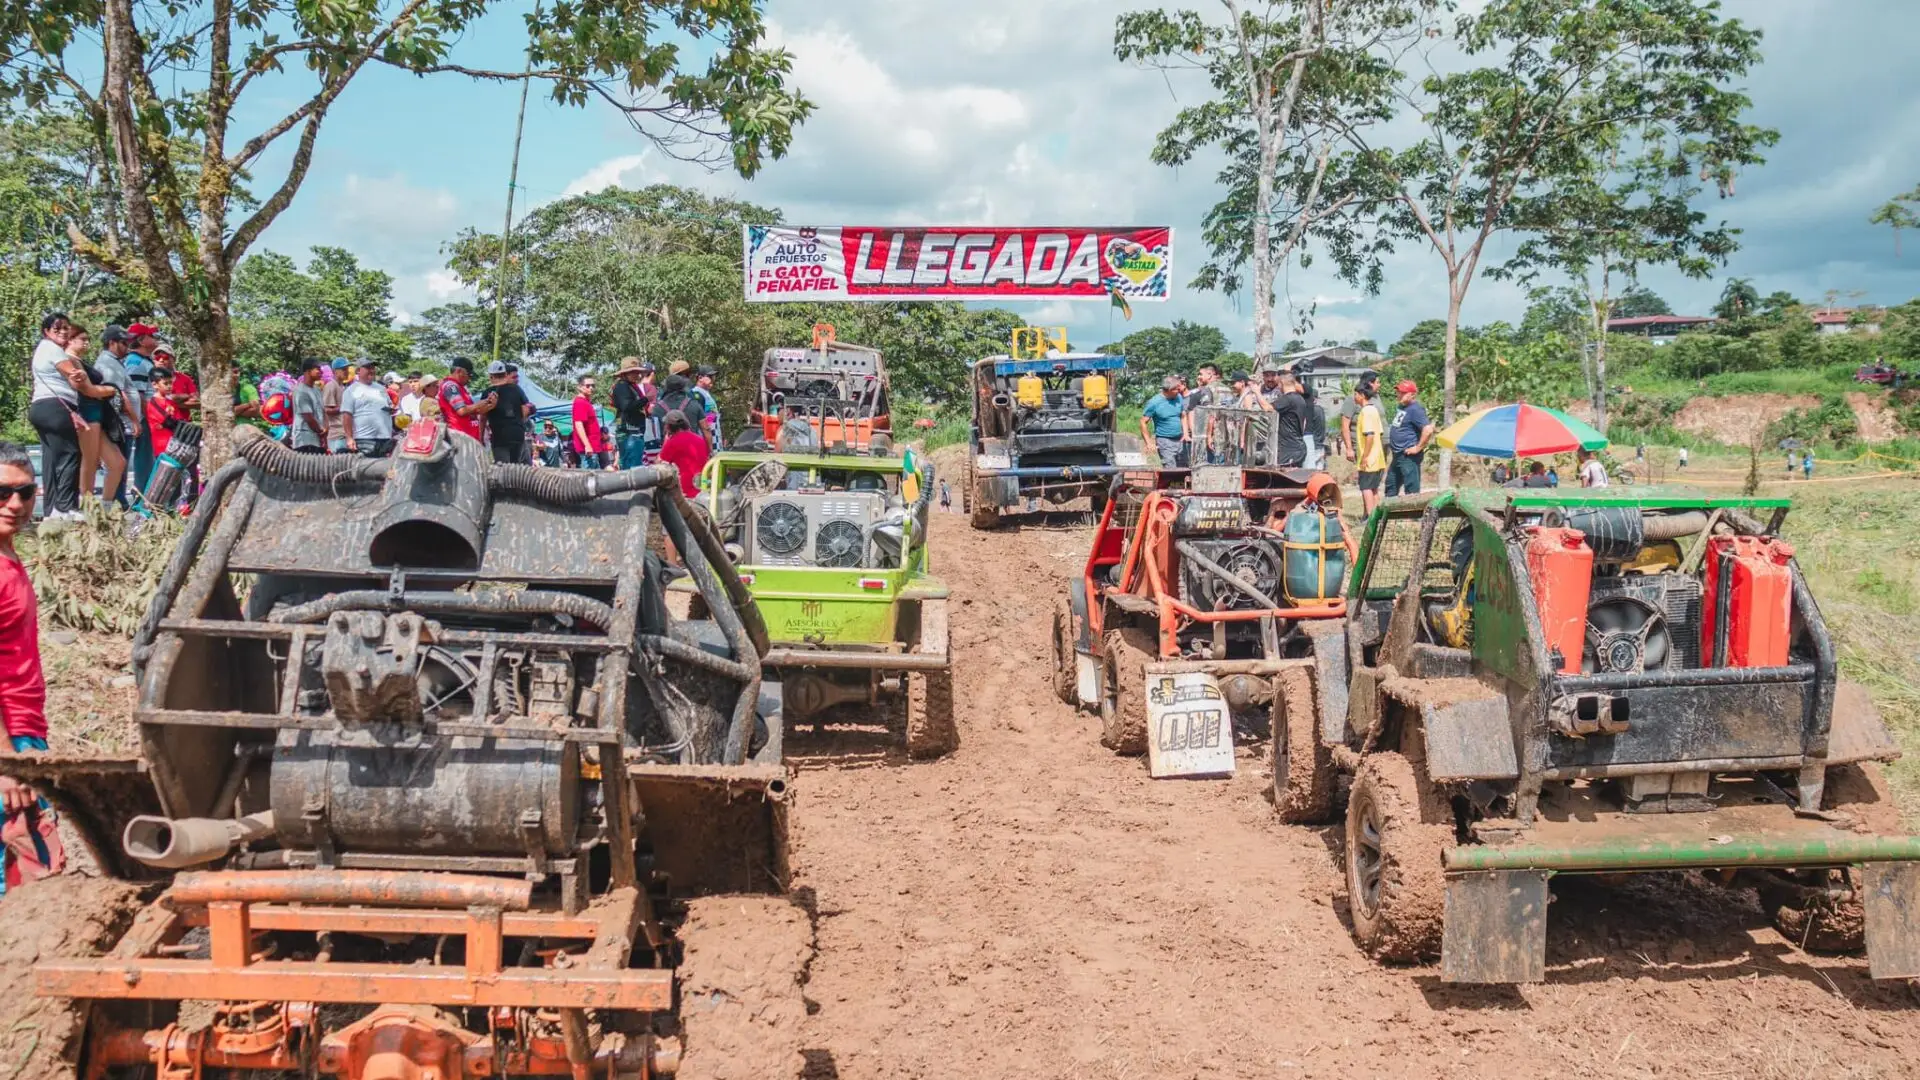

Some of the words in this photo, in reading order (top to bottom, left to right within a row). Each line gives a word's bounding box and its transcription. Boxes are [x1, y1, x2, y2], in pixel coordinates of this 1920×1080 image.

[775, 243, 817, 255] AUTO
[764, 253, 827, 264] REPUESTOS
[851, 232, 1100, 285] LLEGADA
[1124, 260, 1155, 269] PASTAZA
[759, 269, 772, 278] EL
[775, 264, 823, 279] GATO
[1197, 520, 1213, 529] NO
